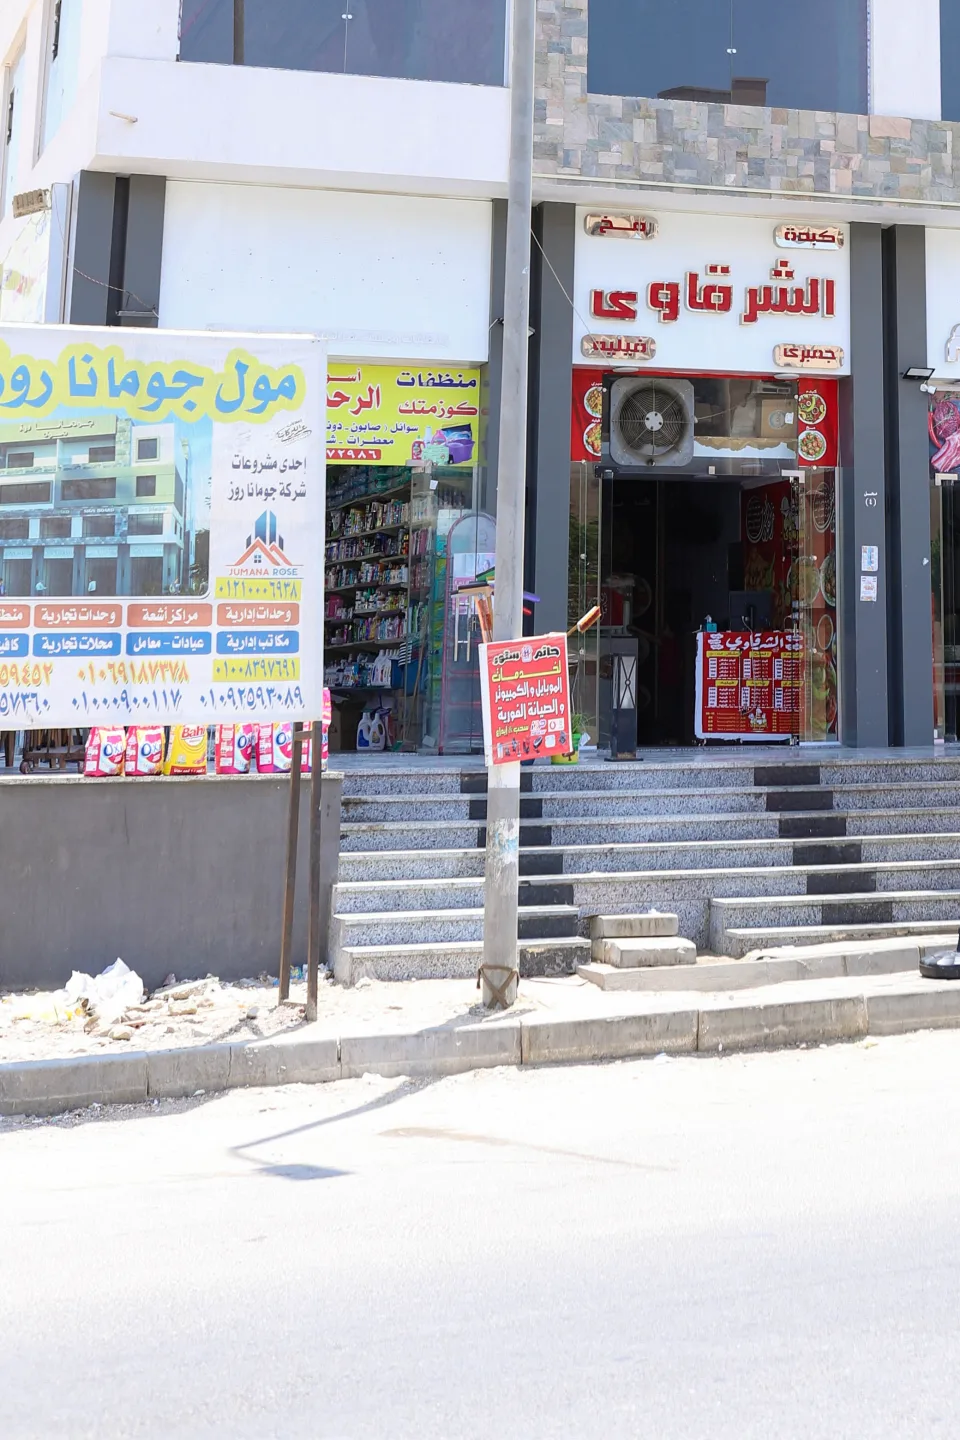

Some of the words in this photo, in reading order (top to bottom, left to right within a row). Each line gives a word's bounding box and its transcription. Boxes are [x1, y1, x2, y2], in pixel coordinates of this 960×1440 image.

[68, 353, 206, 412] جومانا
[215, 359, 297, 414] مول
[396, 371, 477, 388] منظفات
[231, 453, 278, 474] مشروعات
[227, 481, 245, 501] روز
[247, 482, 277, 501] جومانا
[279, 481, 307, 502] شركة
[229, 568, 269, 576] JUMANA
[272, 568, 298, 576] ROSE
[41, 607, 78, 624] تجارية
[78, 607, 116, 624] وحدات
[142, 606, 167, 622] أشعة
[167, 608, 198, 624] مراكز
[225, 606, 256, 623] إدارية
[257, 607, 292, 623] وحدات
[41, 636, 78, 654] تجارية
[78, 636, 114, 650] محلات
[133, 636, 161, 652] معامل
[171, 635, 205, 652] عيادات
[226, 634, 257, 651] إدارية
[258, 634, 290, 651] مكاتب
[534, 645, 561, 660] حاتم
[494, 681, 530, 703] الكمبيوتر
[535, 677, 563, 698] الموبايل
[527, 698, 558, 719] الصيانة
